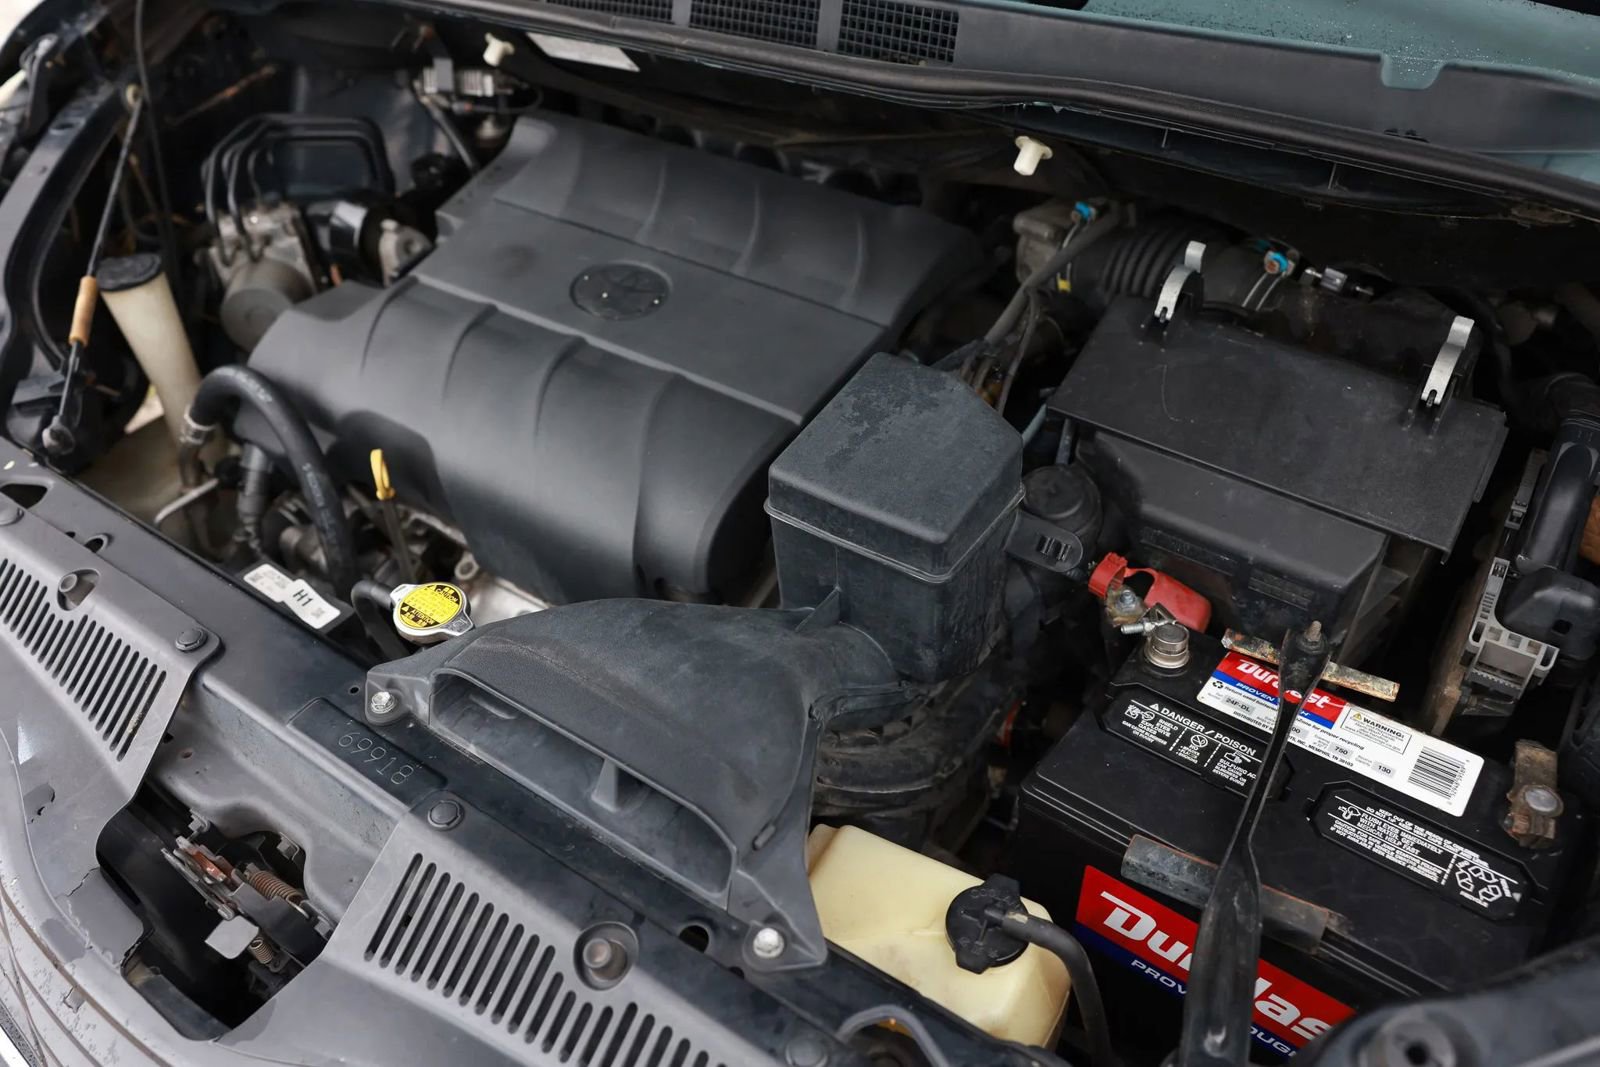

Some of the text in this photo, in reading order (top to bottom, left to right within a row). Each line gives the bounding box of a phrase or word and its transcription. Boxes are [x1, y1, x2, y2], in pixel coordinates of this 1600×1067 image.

[292, 588, 315, 608] H1
[1234, 682, 1275, 701] PROVEN
[1226, 698, 1250, 712] 24F-DL
[1138, 723, 1157, 735] GASES
[1141, 719, 1171, 737] EXPLOSIVE
[1156, 722, 1171, 732] EYES
[1158, 719, 1179, 731] SHIELD
[1161, 708, 1205, 732] DANGER
[1214, 733, 1256, 756] POISON
[1363, 717, 1404, 738] WARNING:
[1339, 737, 1365, 750] recycling
[338, 731, 414, 785] 69918
[1219, 758, 1248, 775] SULFURIC
[1335, 746, 1348, 755] 750
[1378, 765, 1391, 774] 130
[1357, 822, 1420, 855] MEDICAL HELP FAST
[1360, 817, 1376, 828] WITH
[1401, 837, 1415, 847] GET
[1361, 813, 1443, 854] FLUSH EYES IMMEDIATELY
[1130, 959, 1188, 996] PROV
